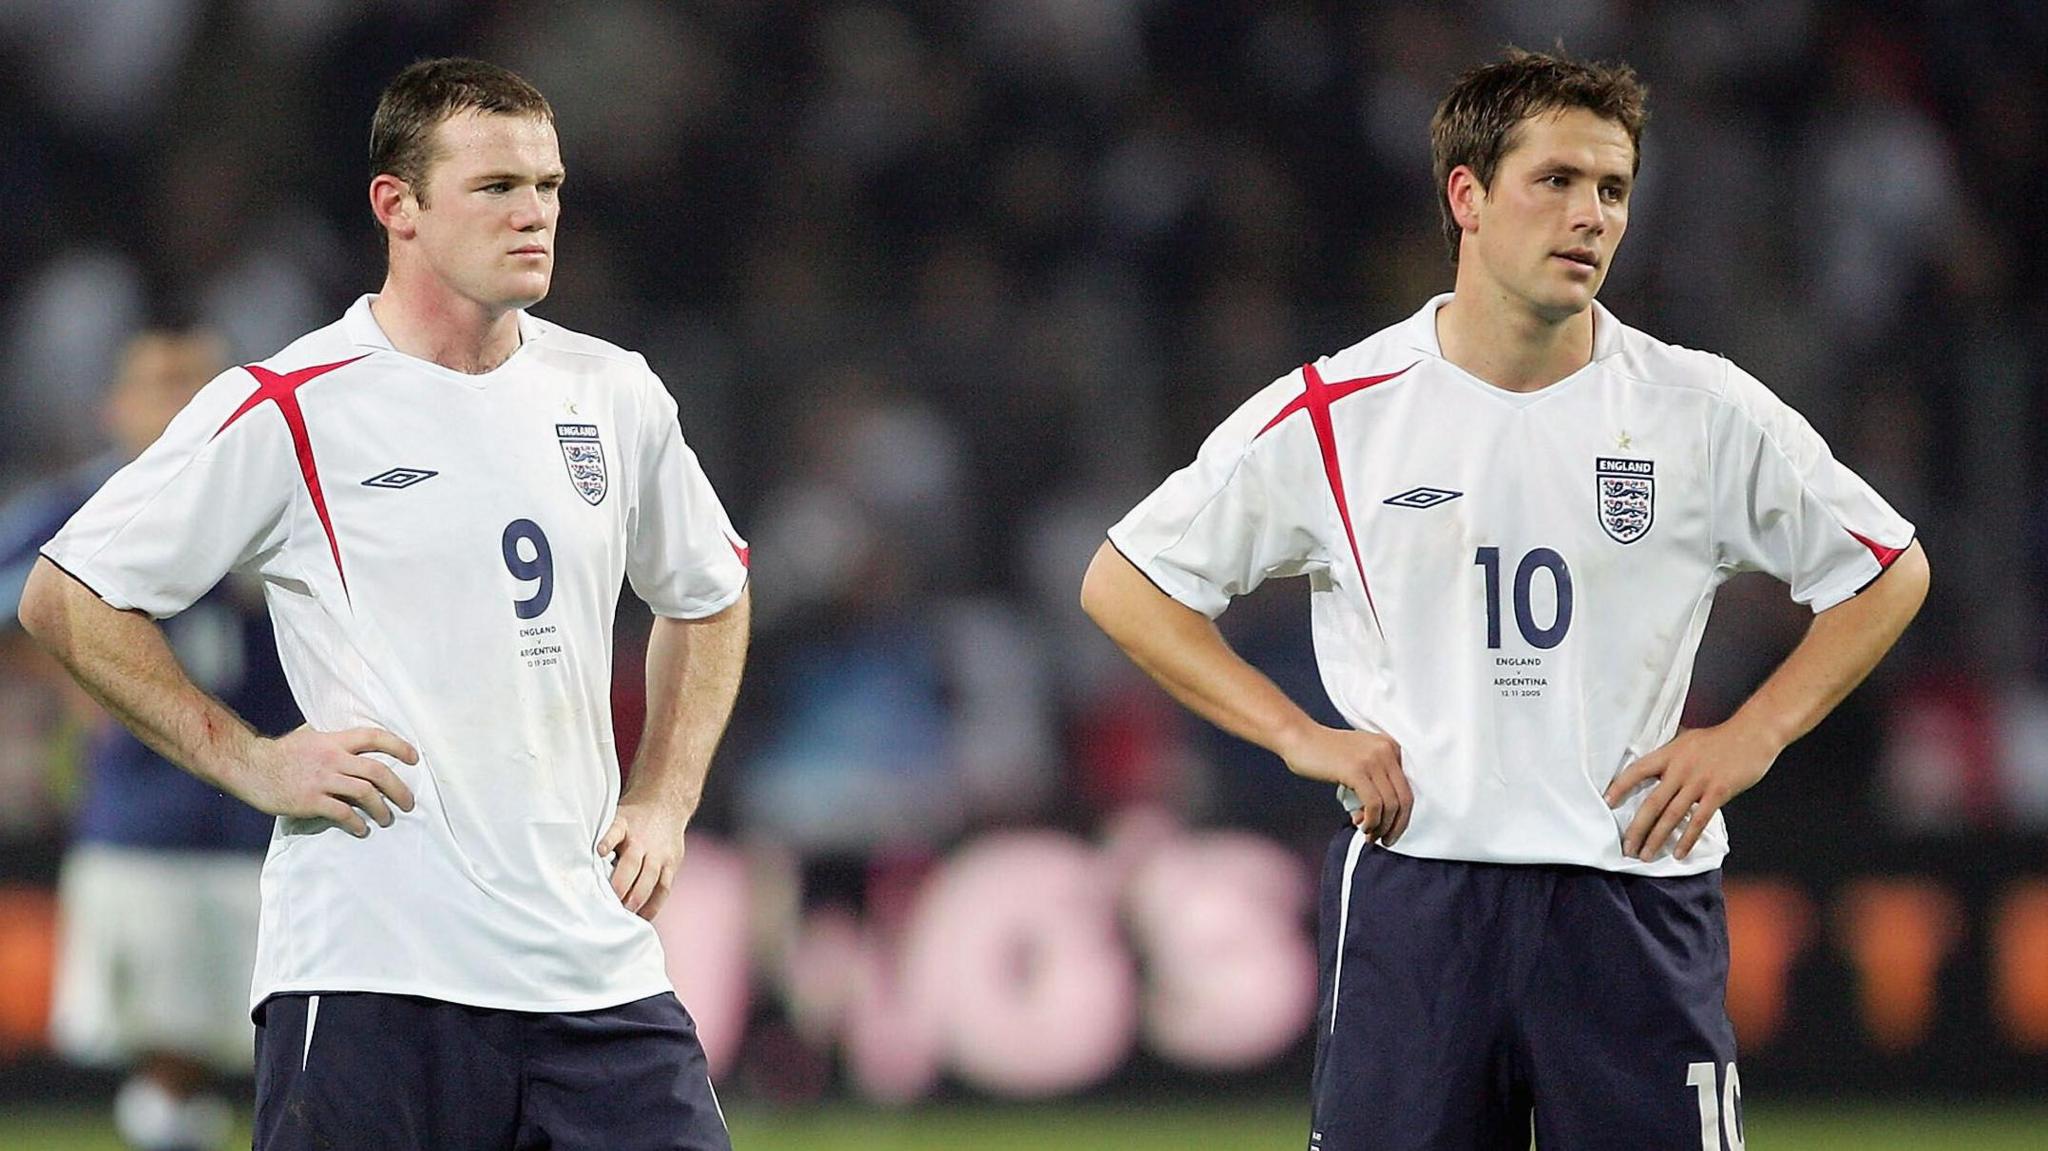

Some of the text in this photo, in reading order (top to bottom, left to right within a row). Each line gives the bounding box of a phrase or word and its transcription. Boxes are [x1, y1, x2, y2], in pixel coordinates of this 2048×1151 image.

[558, 426, 597, 437] ENGLAND
[1599, 460, 1651, 473] ENGLAND
[502, 518, 554, 620] 9
[1475, 546, 1574, 650] 10
[519, 626, 557, 637] ENGLAND
[520, 645, 561, 657] ARGENTINA
[1495, 657, 1542, 666] ENGLAND
[1494, 678, 1548, 686] ARGENTINA
